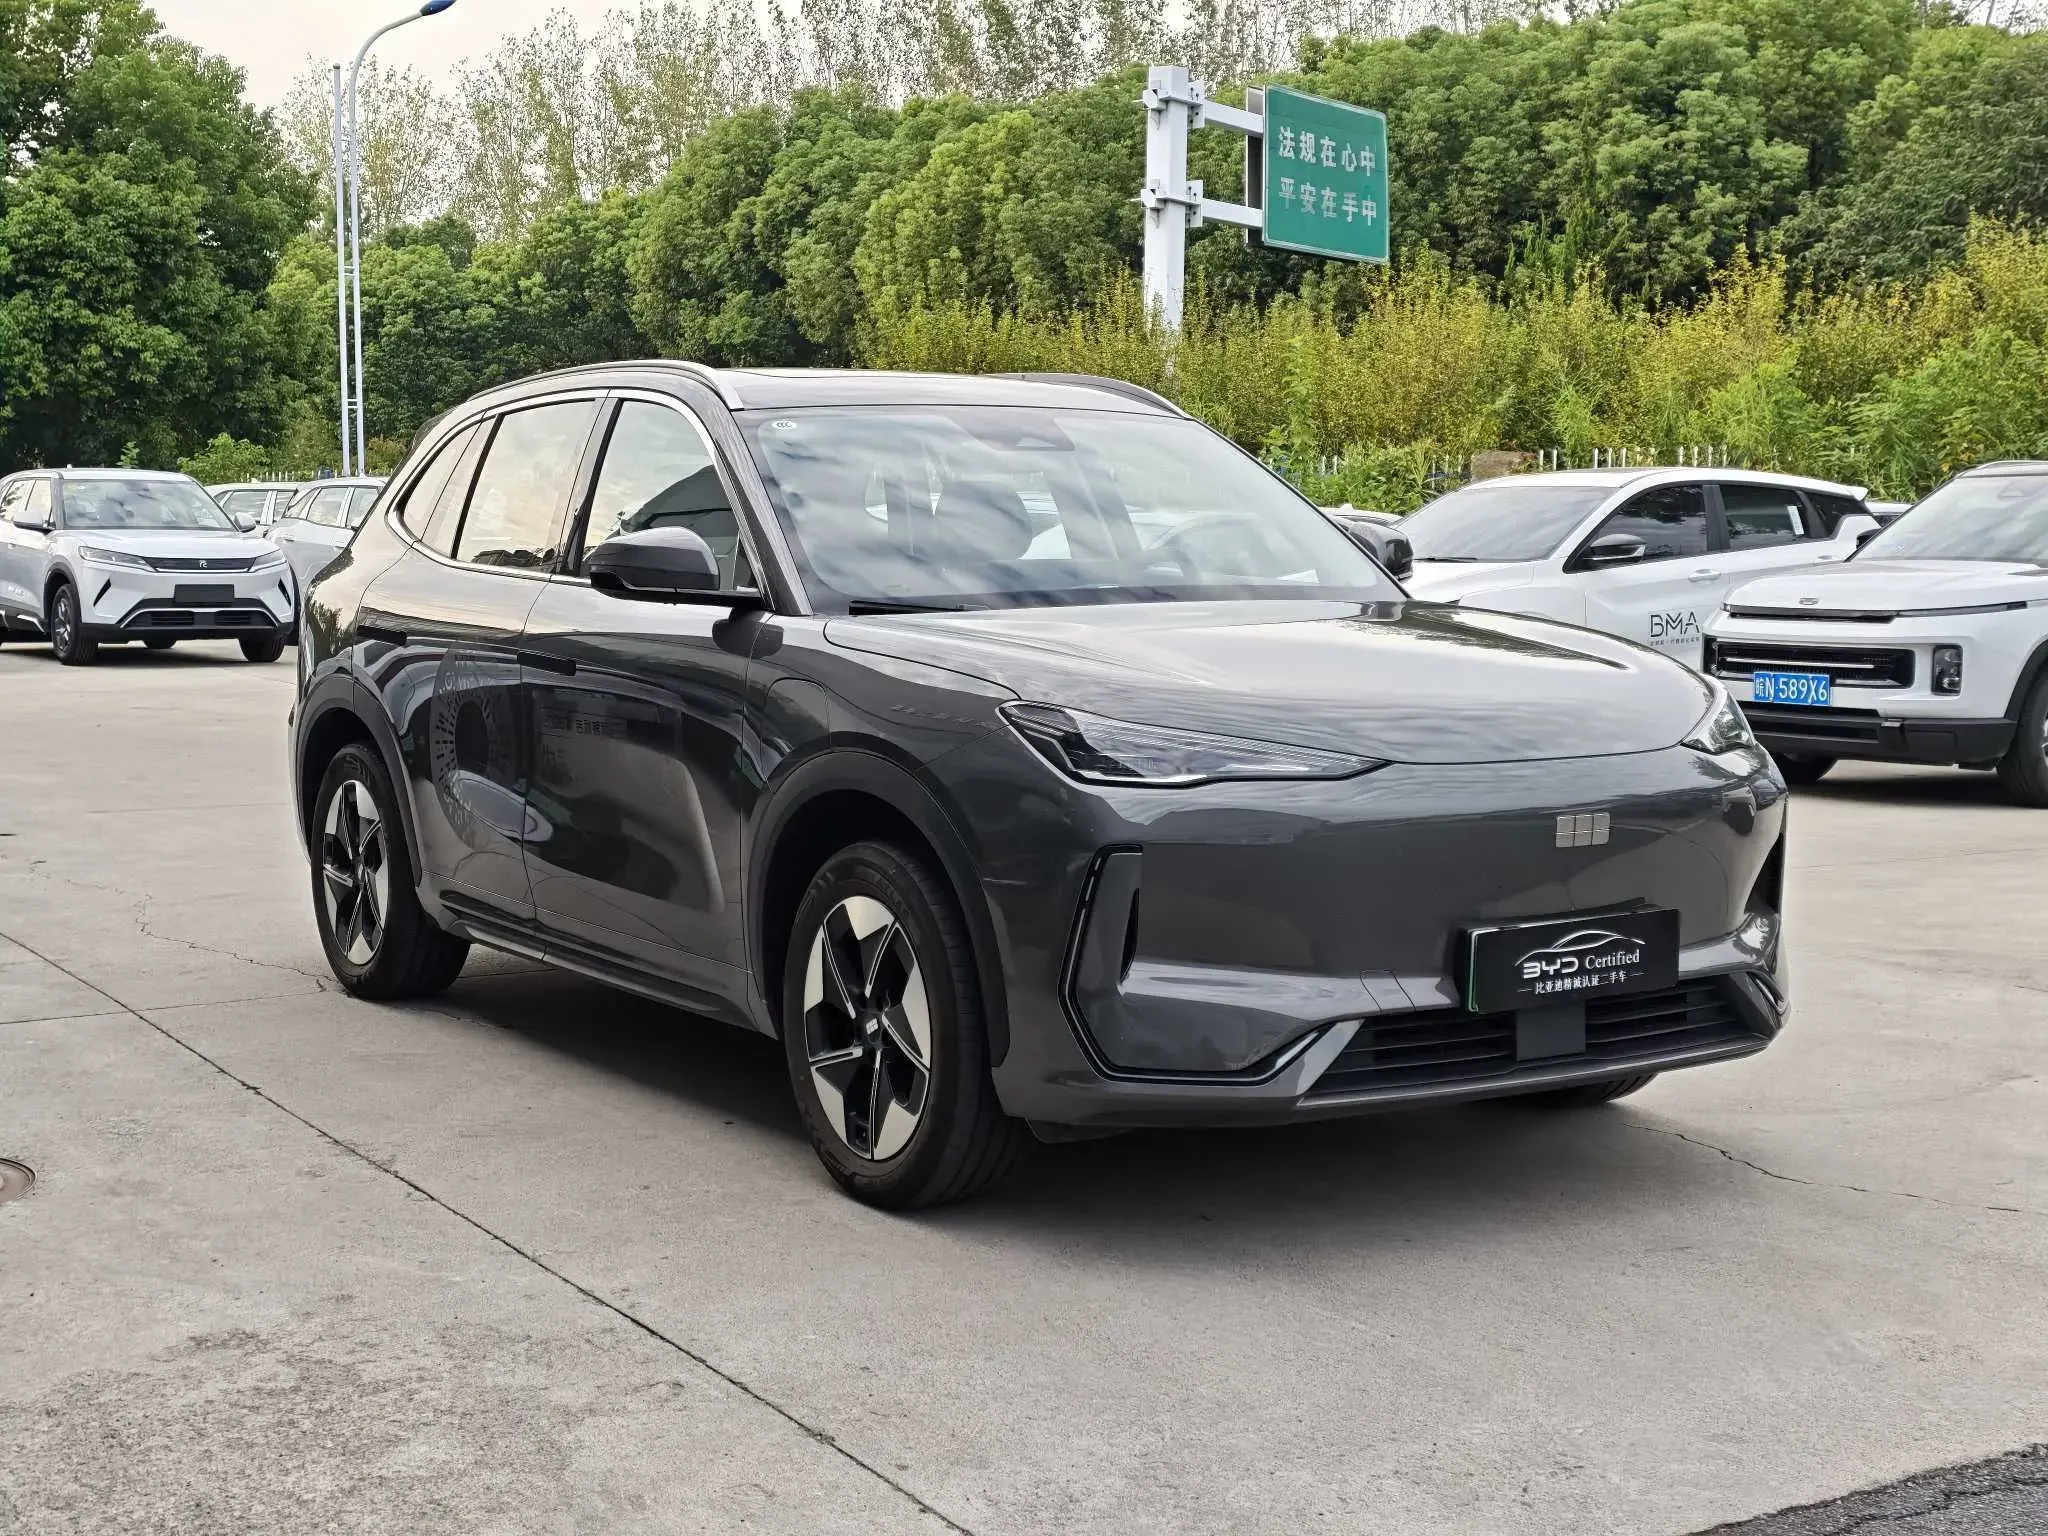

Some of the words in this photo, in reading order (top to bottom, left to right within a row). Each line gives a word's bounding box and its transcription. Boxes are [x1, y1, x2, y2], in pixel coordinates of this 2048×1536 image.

[1278, 125, 1376, 177] 法规在心中
[1279, 176, 1377, 226] 平安在手中
[1650, 611, 1700, 638] BMA
[1523, 957, 1579, 979] BYD
[1585, 949, 1640, 970] Certified
